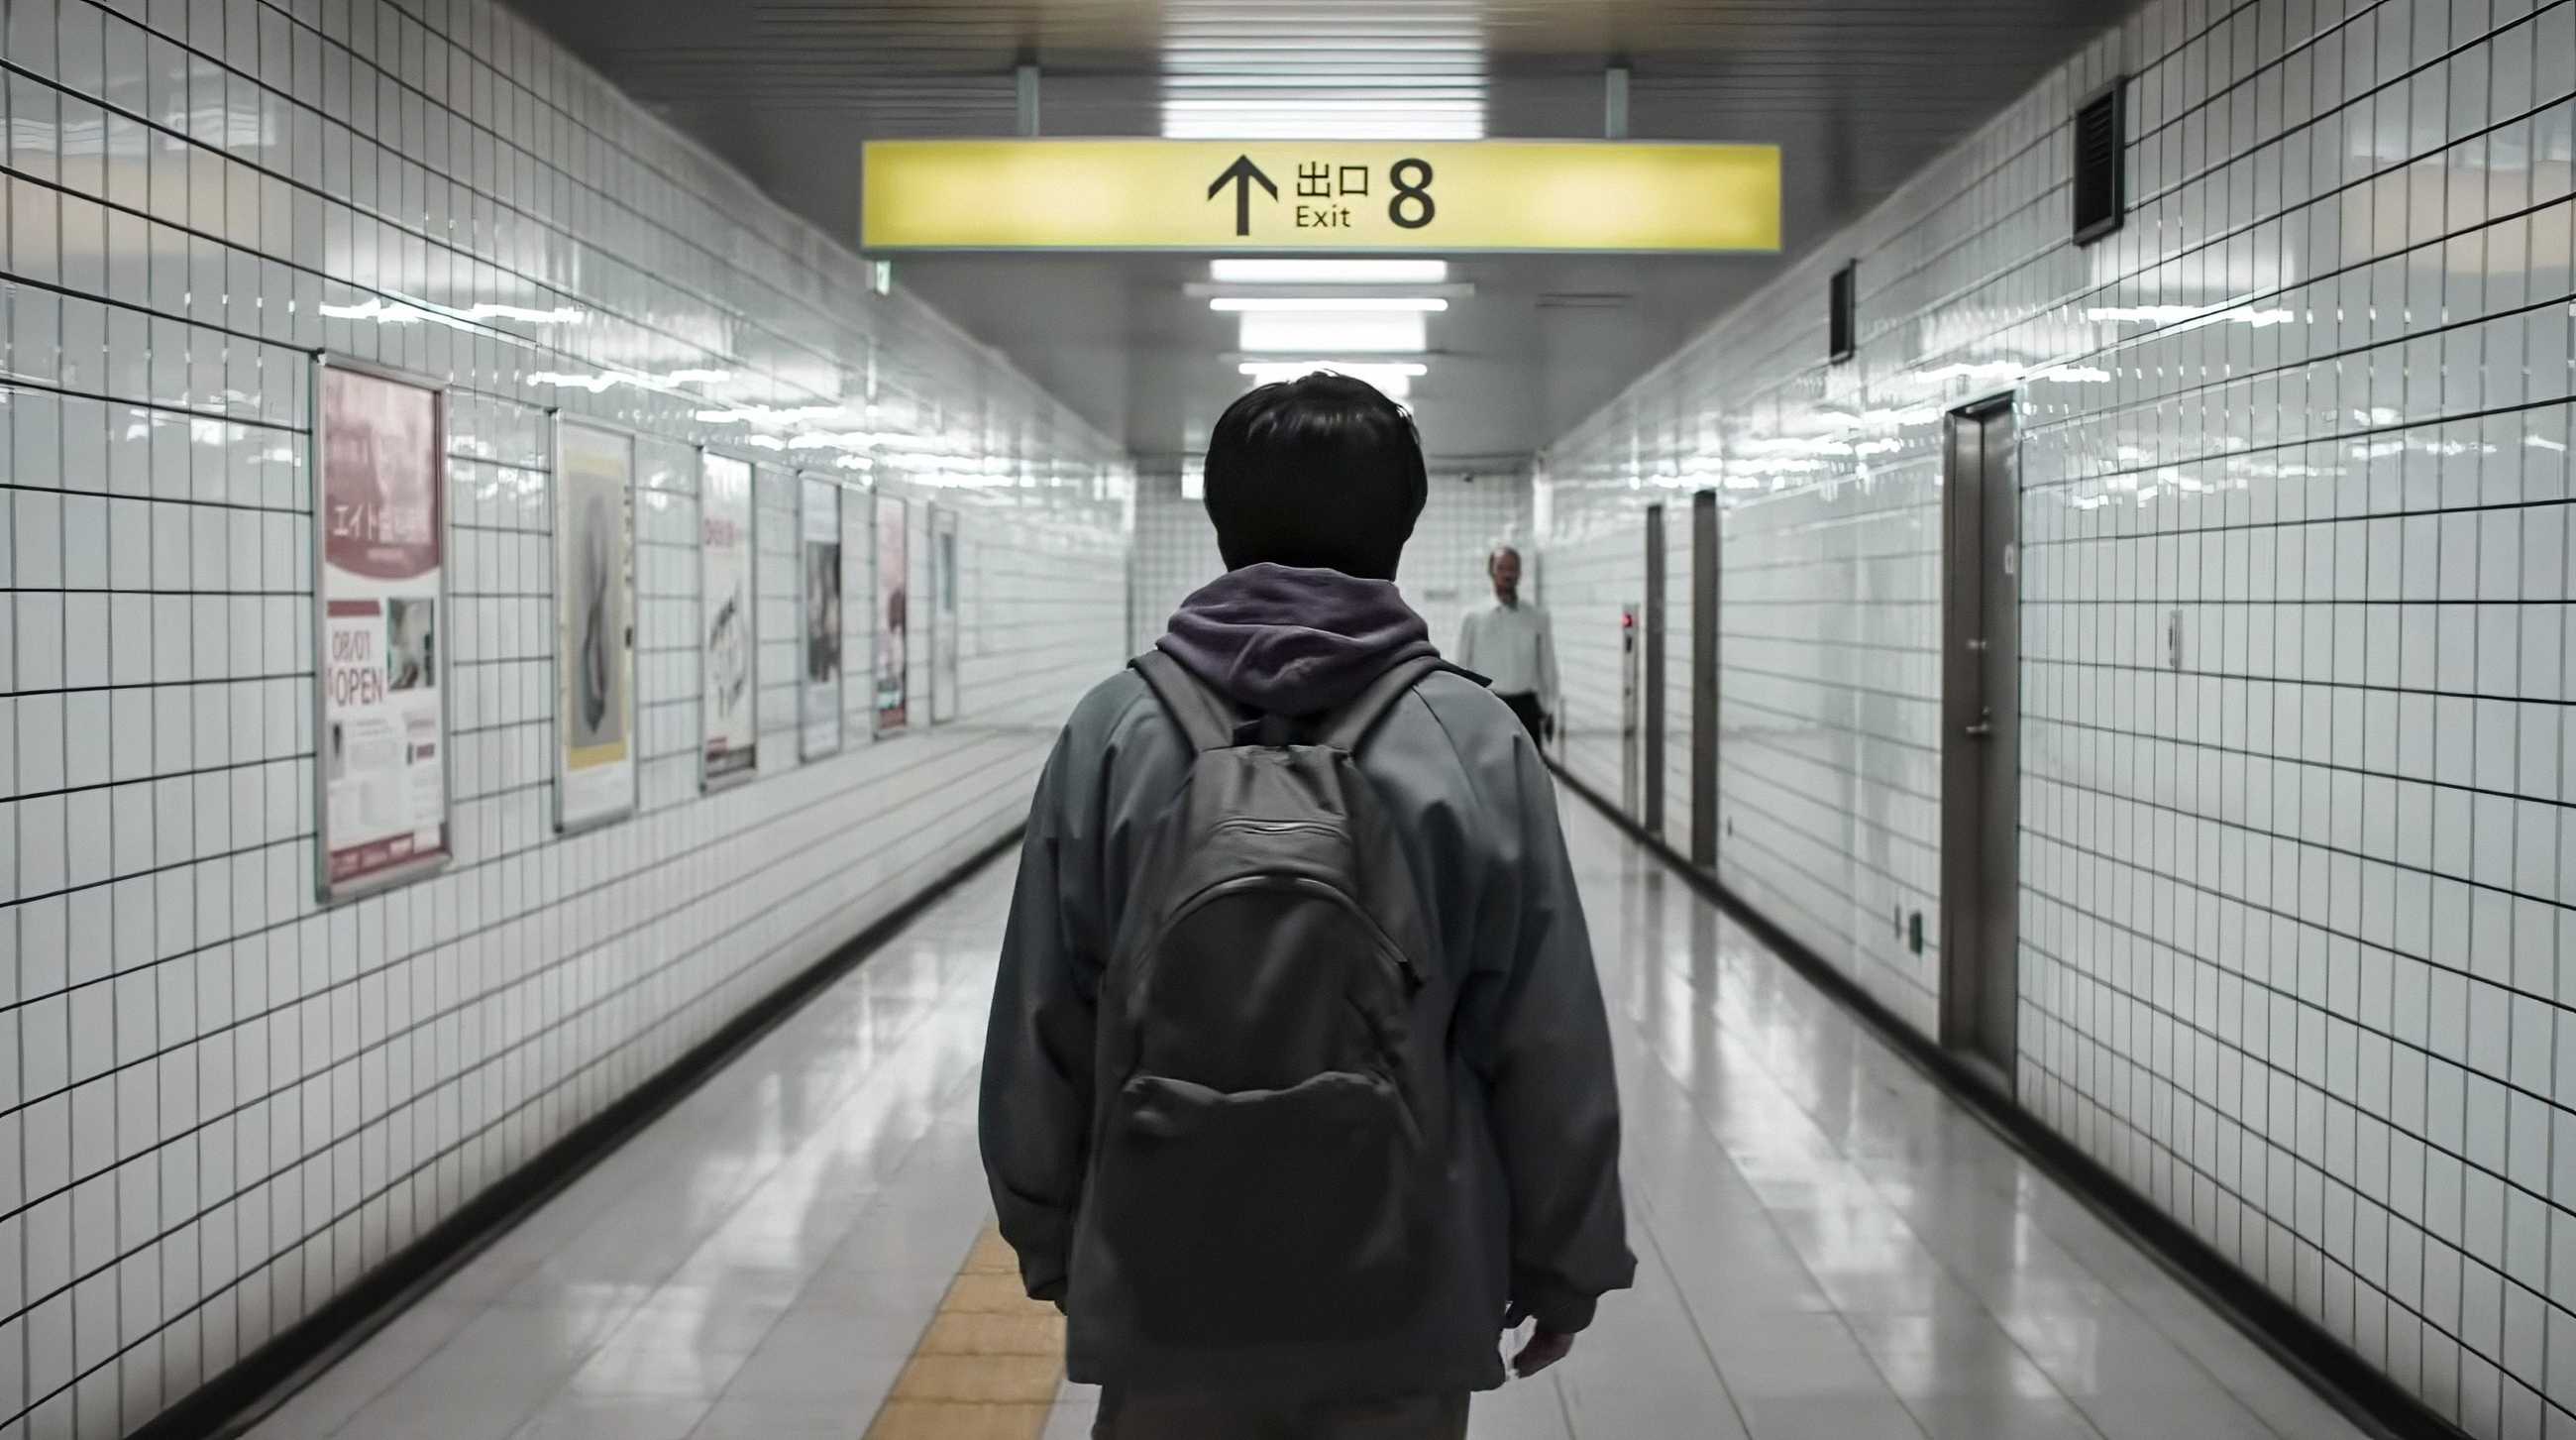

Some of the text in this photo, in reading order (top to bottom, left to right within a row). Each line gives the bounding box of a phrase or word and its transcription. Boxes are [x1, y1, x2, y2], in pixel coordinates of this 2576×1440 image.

[1296, 161, 1368, 197] 出口
[1388, 158, 1436, 229] 8
[1296, 204, 1351, 228] Exit
[336, 667, 382, 707] OPEN
